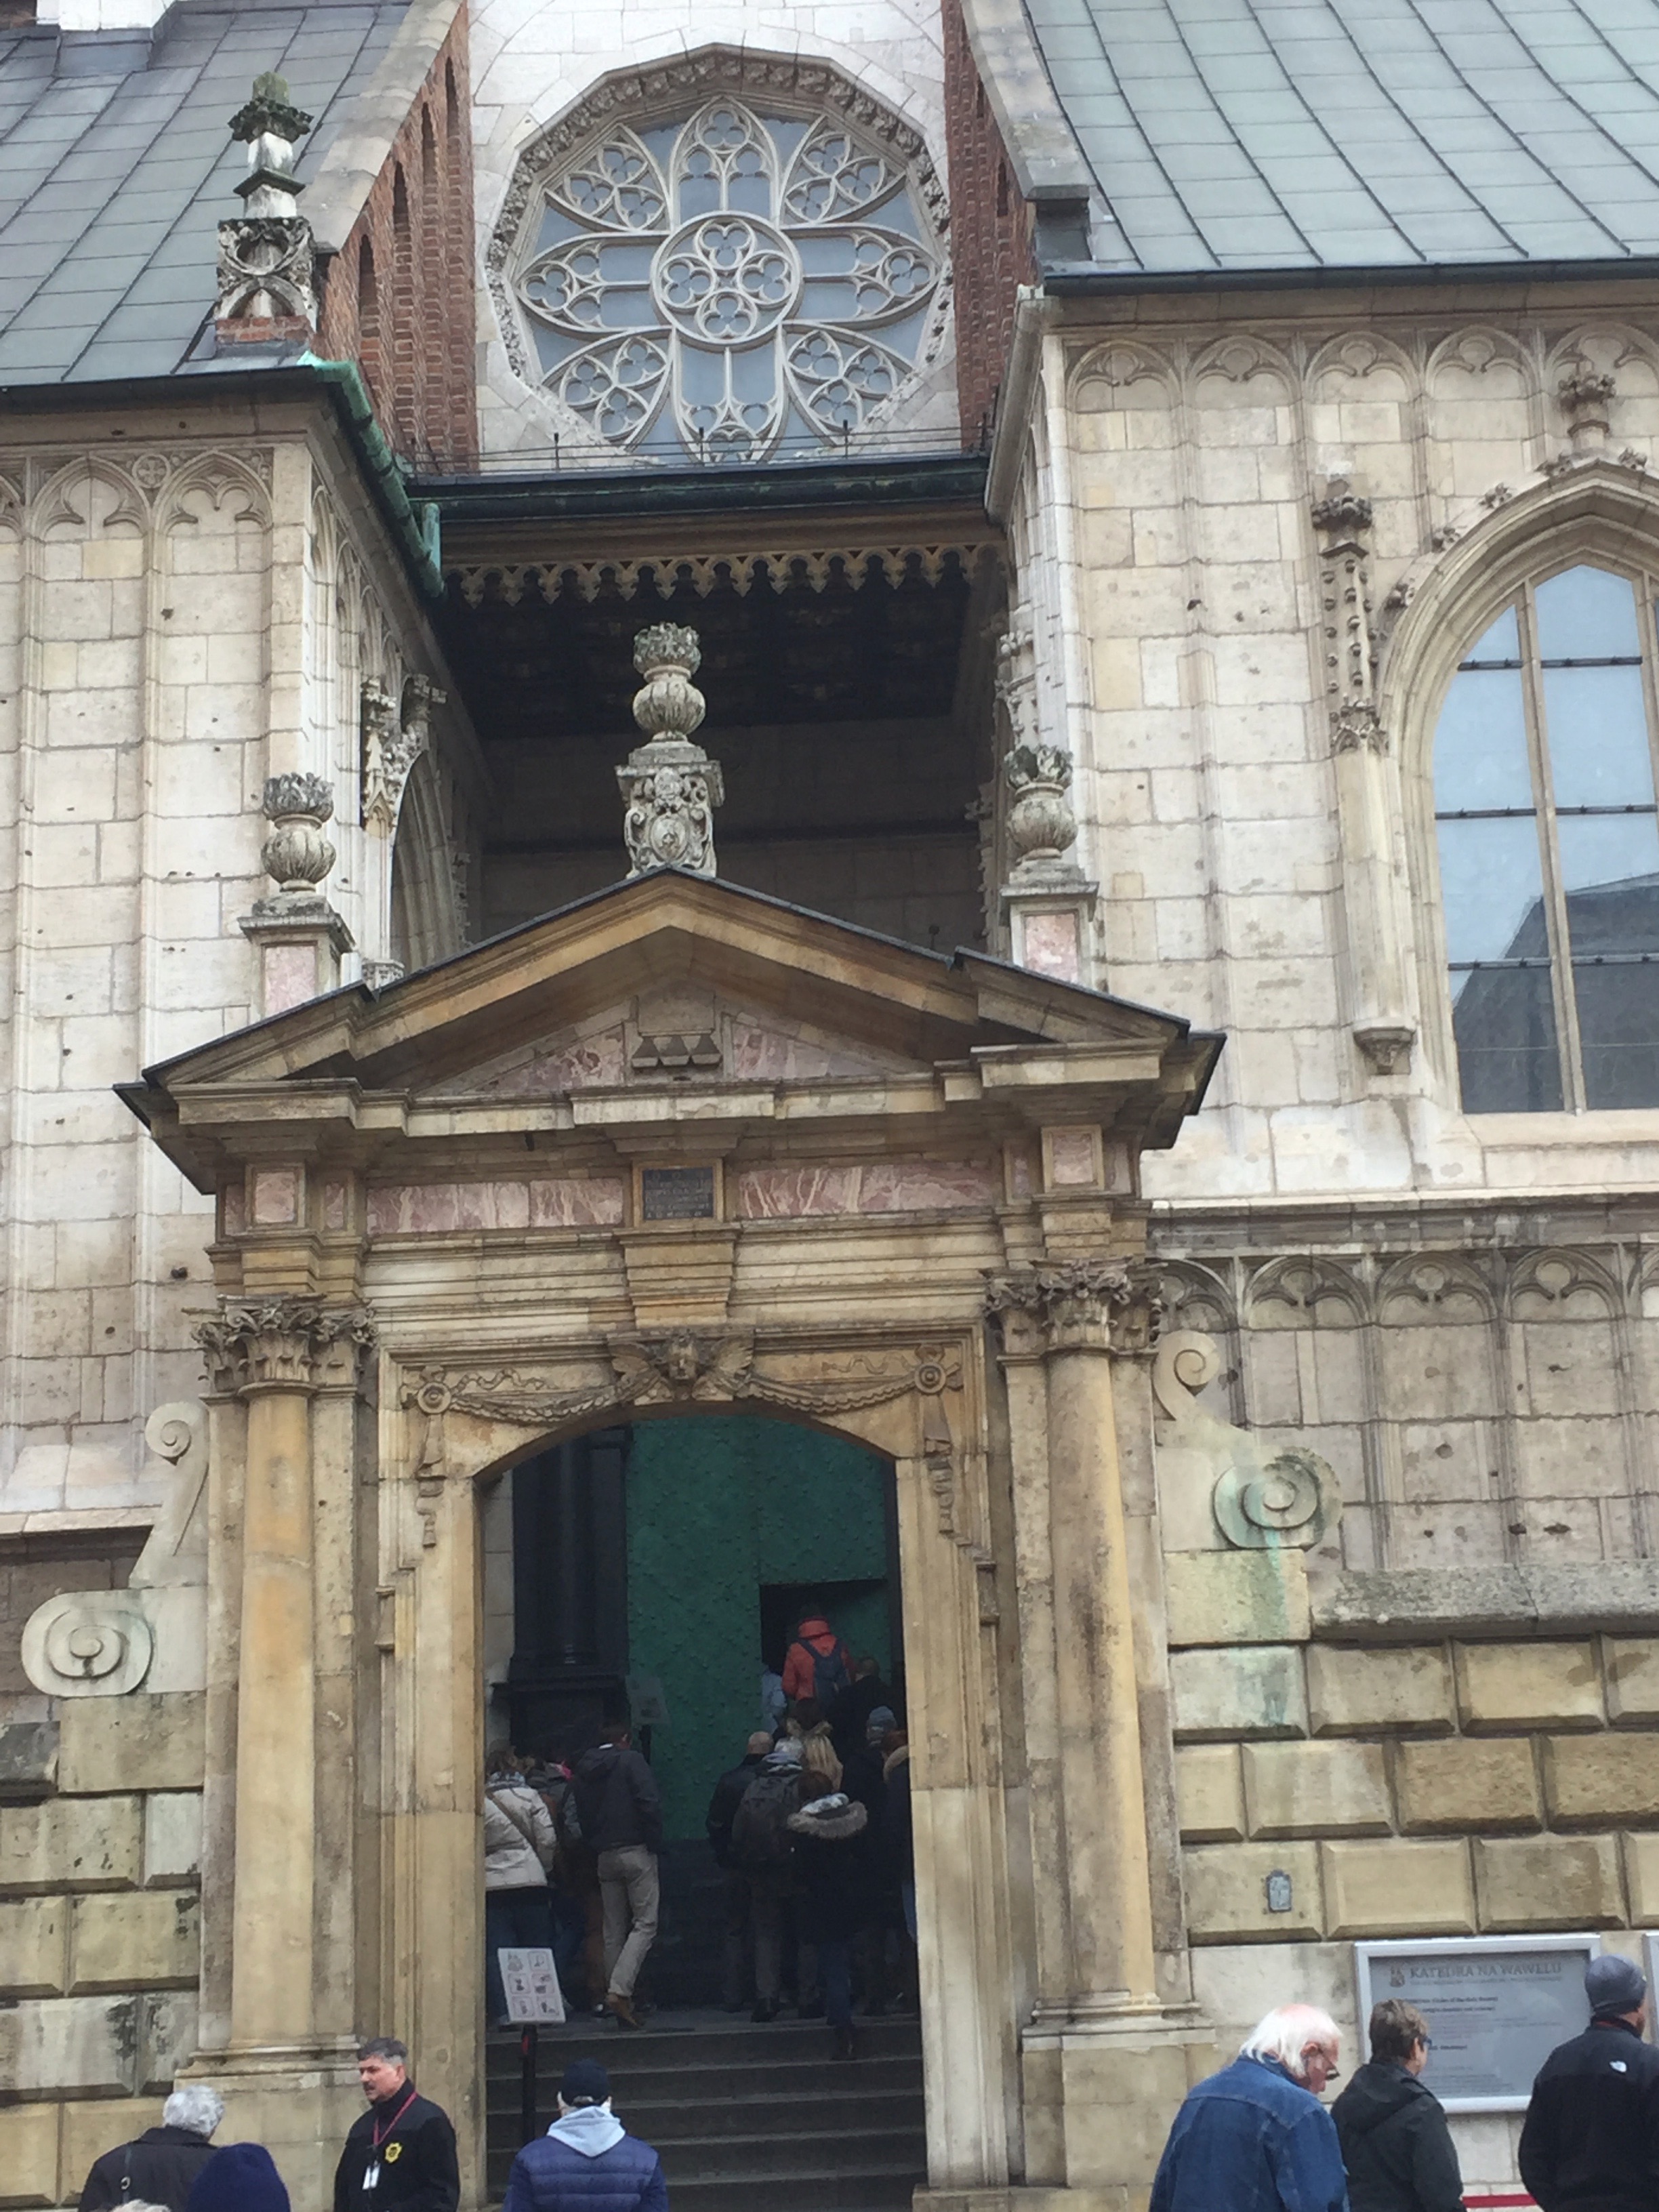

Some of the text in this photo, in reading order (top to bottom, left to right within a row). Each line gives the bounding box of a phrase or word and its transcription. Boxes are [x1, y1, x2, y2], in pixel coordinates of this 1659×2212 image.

[1410, 1963, 1561, 1978] KATEDRA NA WAWELU
